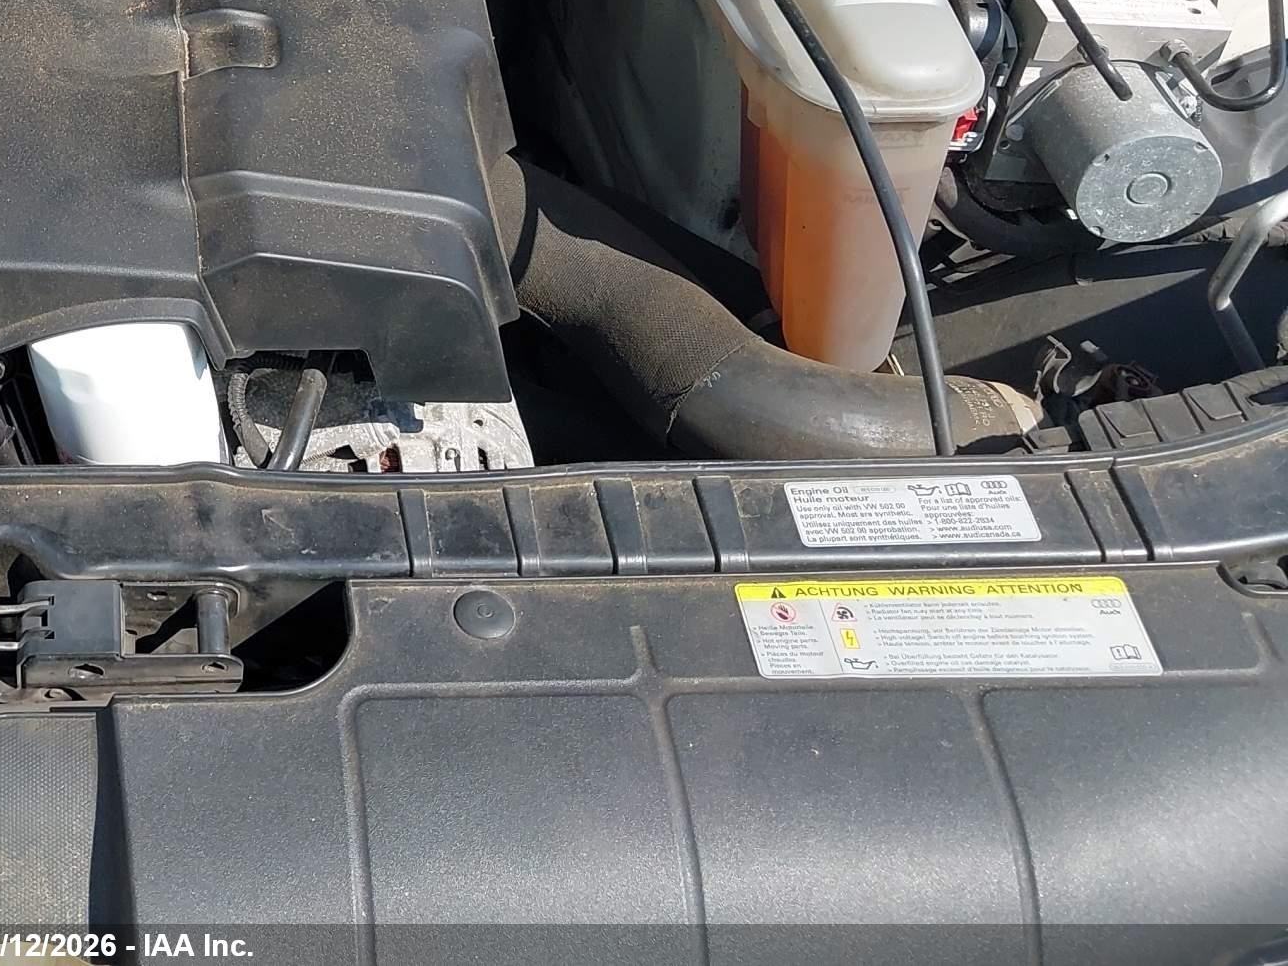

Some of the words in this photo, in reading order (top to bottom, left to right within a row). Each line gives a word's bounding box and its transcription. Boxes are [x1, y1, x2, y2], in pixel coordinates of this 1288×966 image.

[791, 487, 829, 496] Engine
[833, 486, 848, 494] Oil
[826, 495, 869, 503] moteur
[813, 505, 830, 513] only
[800, 512, 836, 520] approval.
[832, 520, 881, 528] uniquement
[868, 526, 921, 534] approbation.
[818, 535, 848, 543] plupart
[868, 534, 922, 542] synthétiques.
[795, 587, 879, 597] ACHTUNG
[888, 585, 976, 596] WARNING
[986, 583, 1083, 594] ATTENTION
